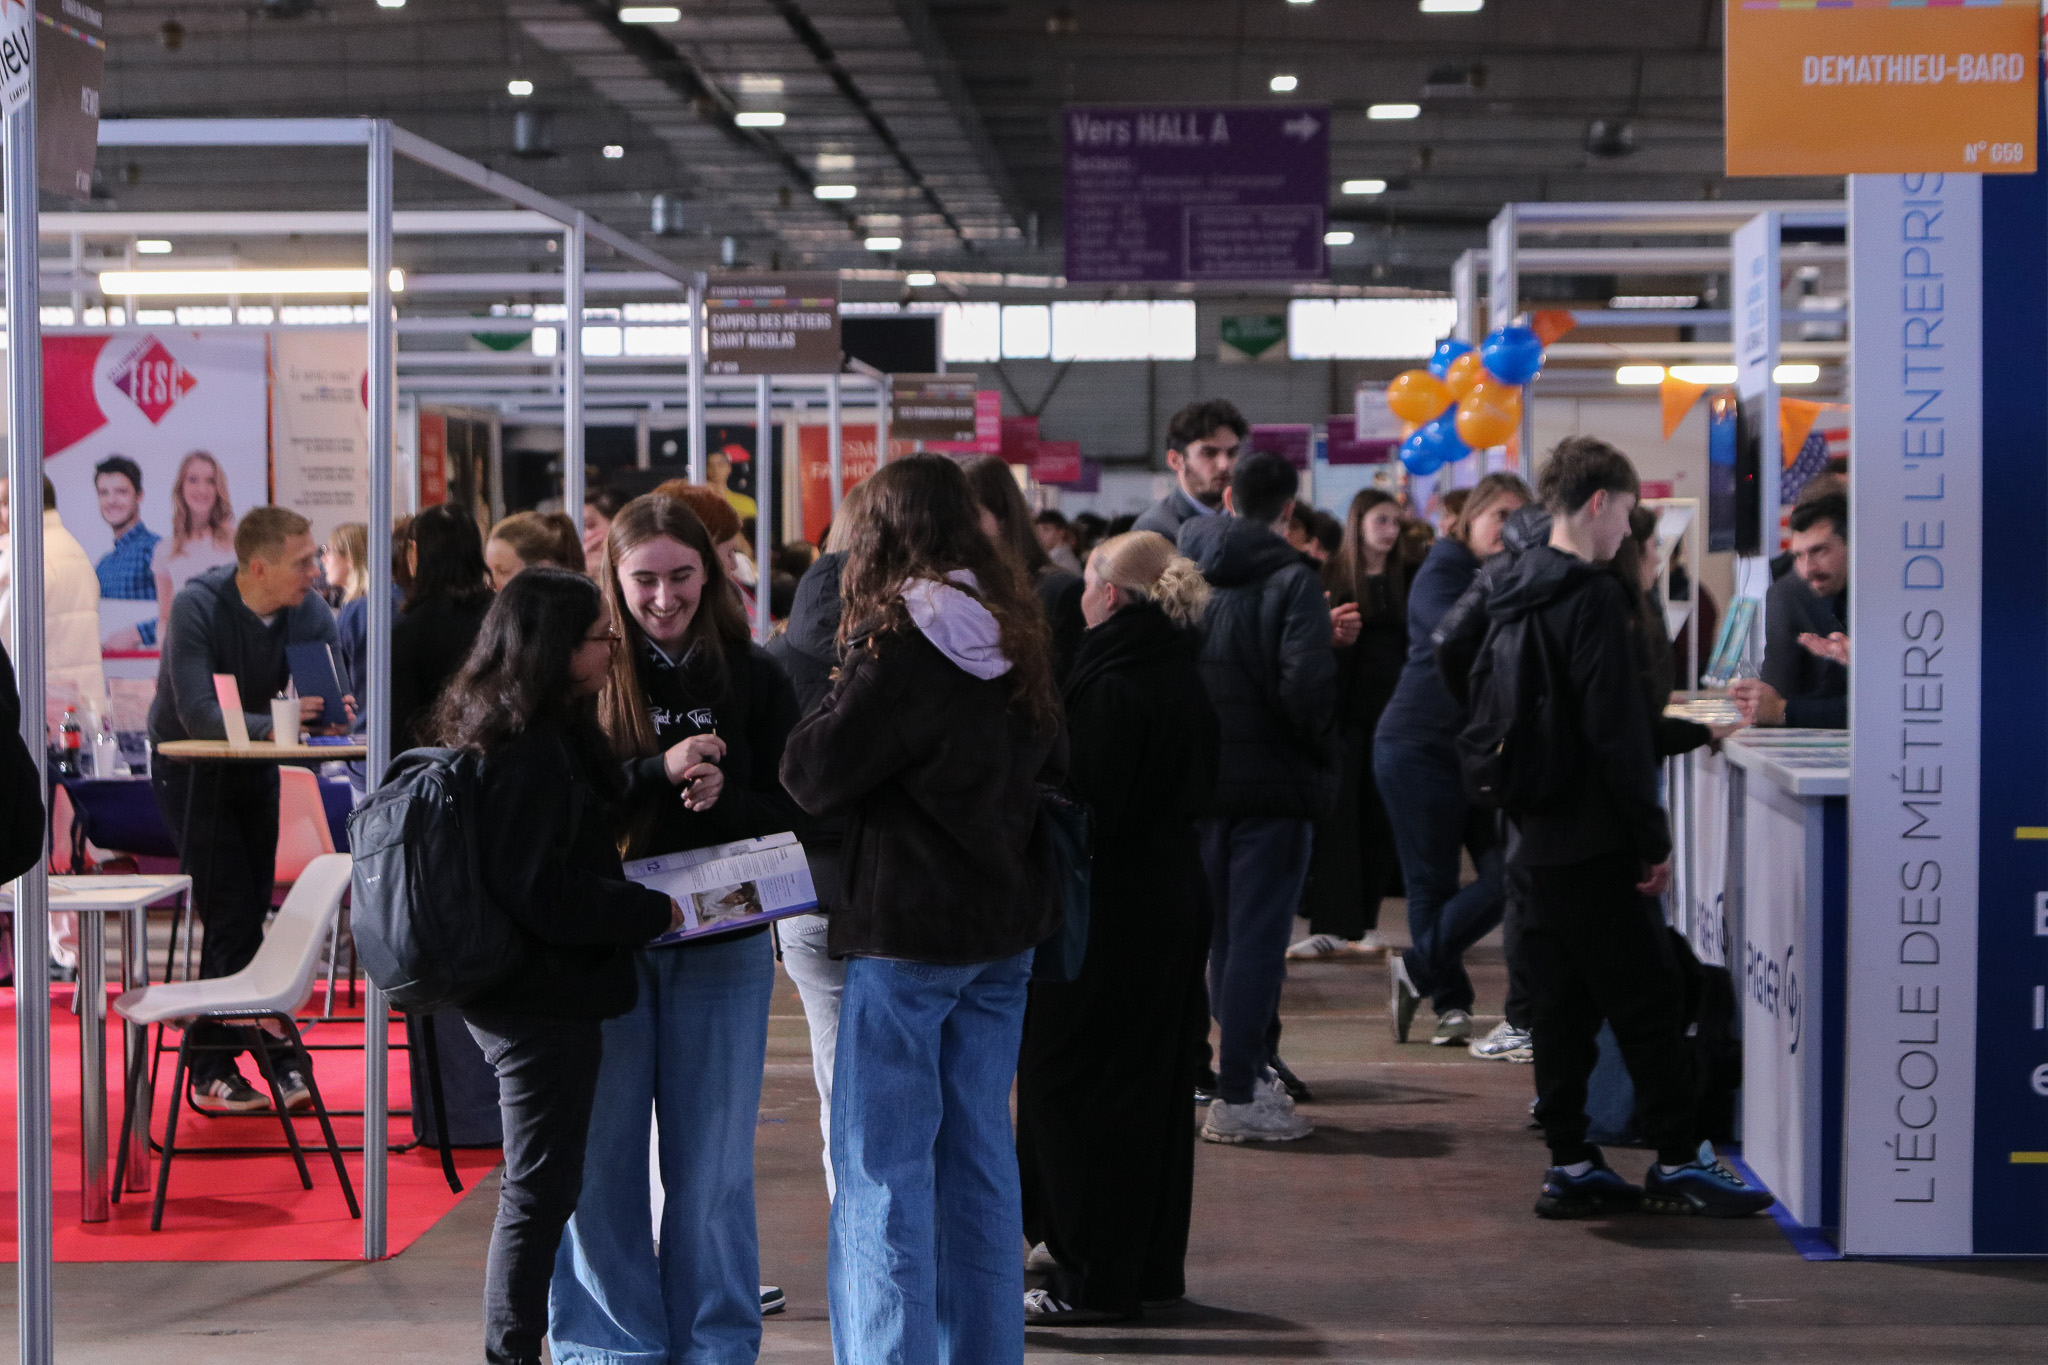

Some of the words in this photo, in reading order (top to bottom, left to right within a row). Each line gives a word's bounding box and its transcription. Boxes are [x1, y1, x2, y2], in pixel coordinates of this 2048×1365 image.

[1803, 53, 2025, 85] DEMATHIEU-BARD
[1071, 113, 1131, 146] Vers
[1136, 113, 1204, 146] HALL
[1210, 113, 1231, 145] A
[1964, 140, 1988, 163] N°
[1990, 143, 2024, 163] G59
[711, 313, 757, 330] CAMPUS
[758, 313, 782, 330] DES
[783, 310, 832, 330] MÉTIERS
[711, 332, 744, 349] SAINT
[747, 332, 796, 349] NICOLAS
[1903, 520, 1945, 591] DE
[1891, 608, 1944, 840] MÉTIERS
[1900, 860, 1942, 965] DES
[1747, 939, 1780, 1020] PIGIER
[1885, 985, 1940, 1203] L'ÉCOLE
